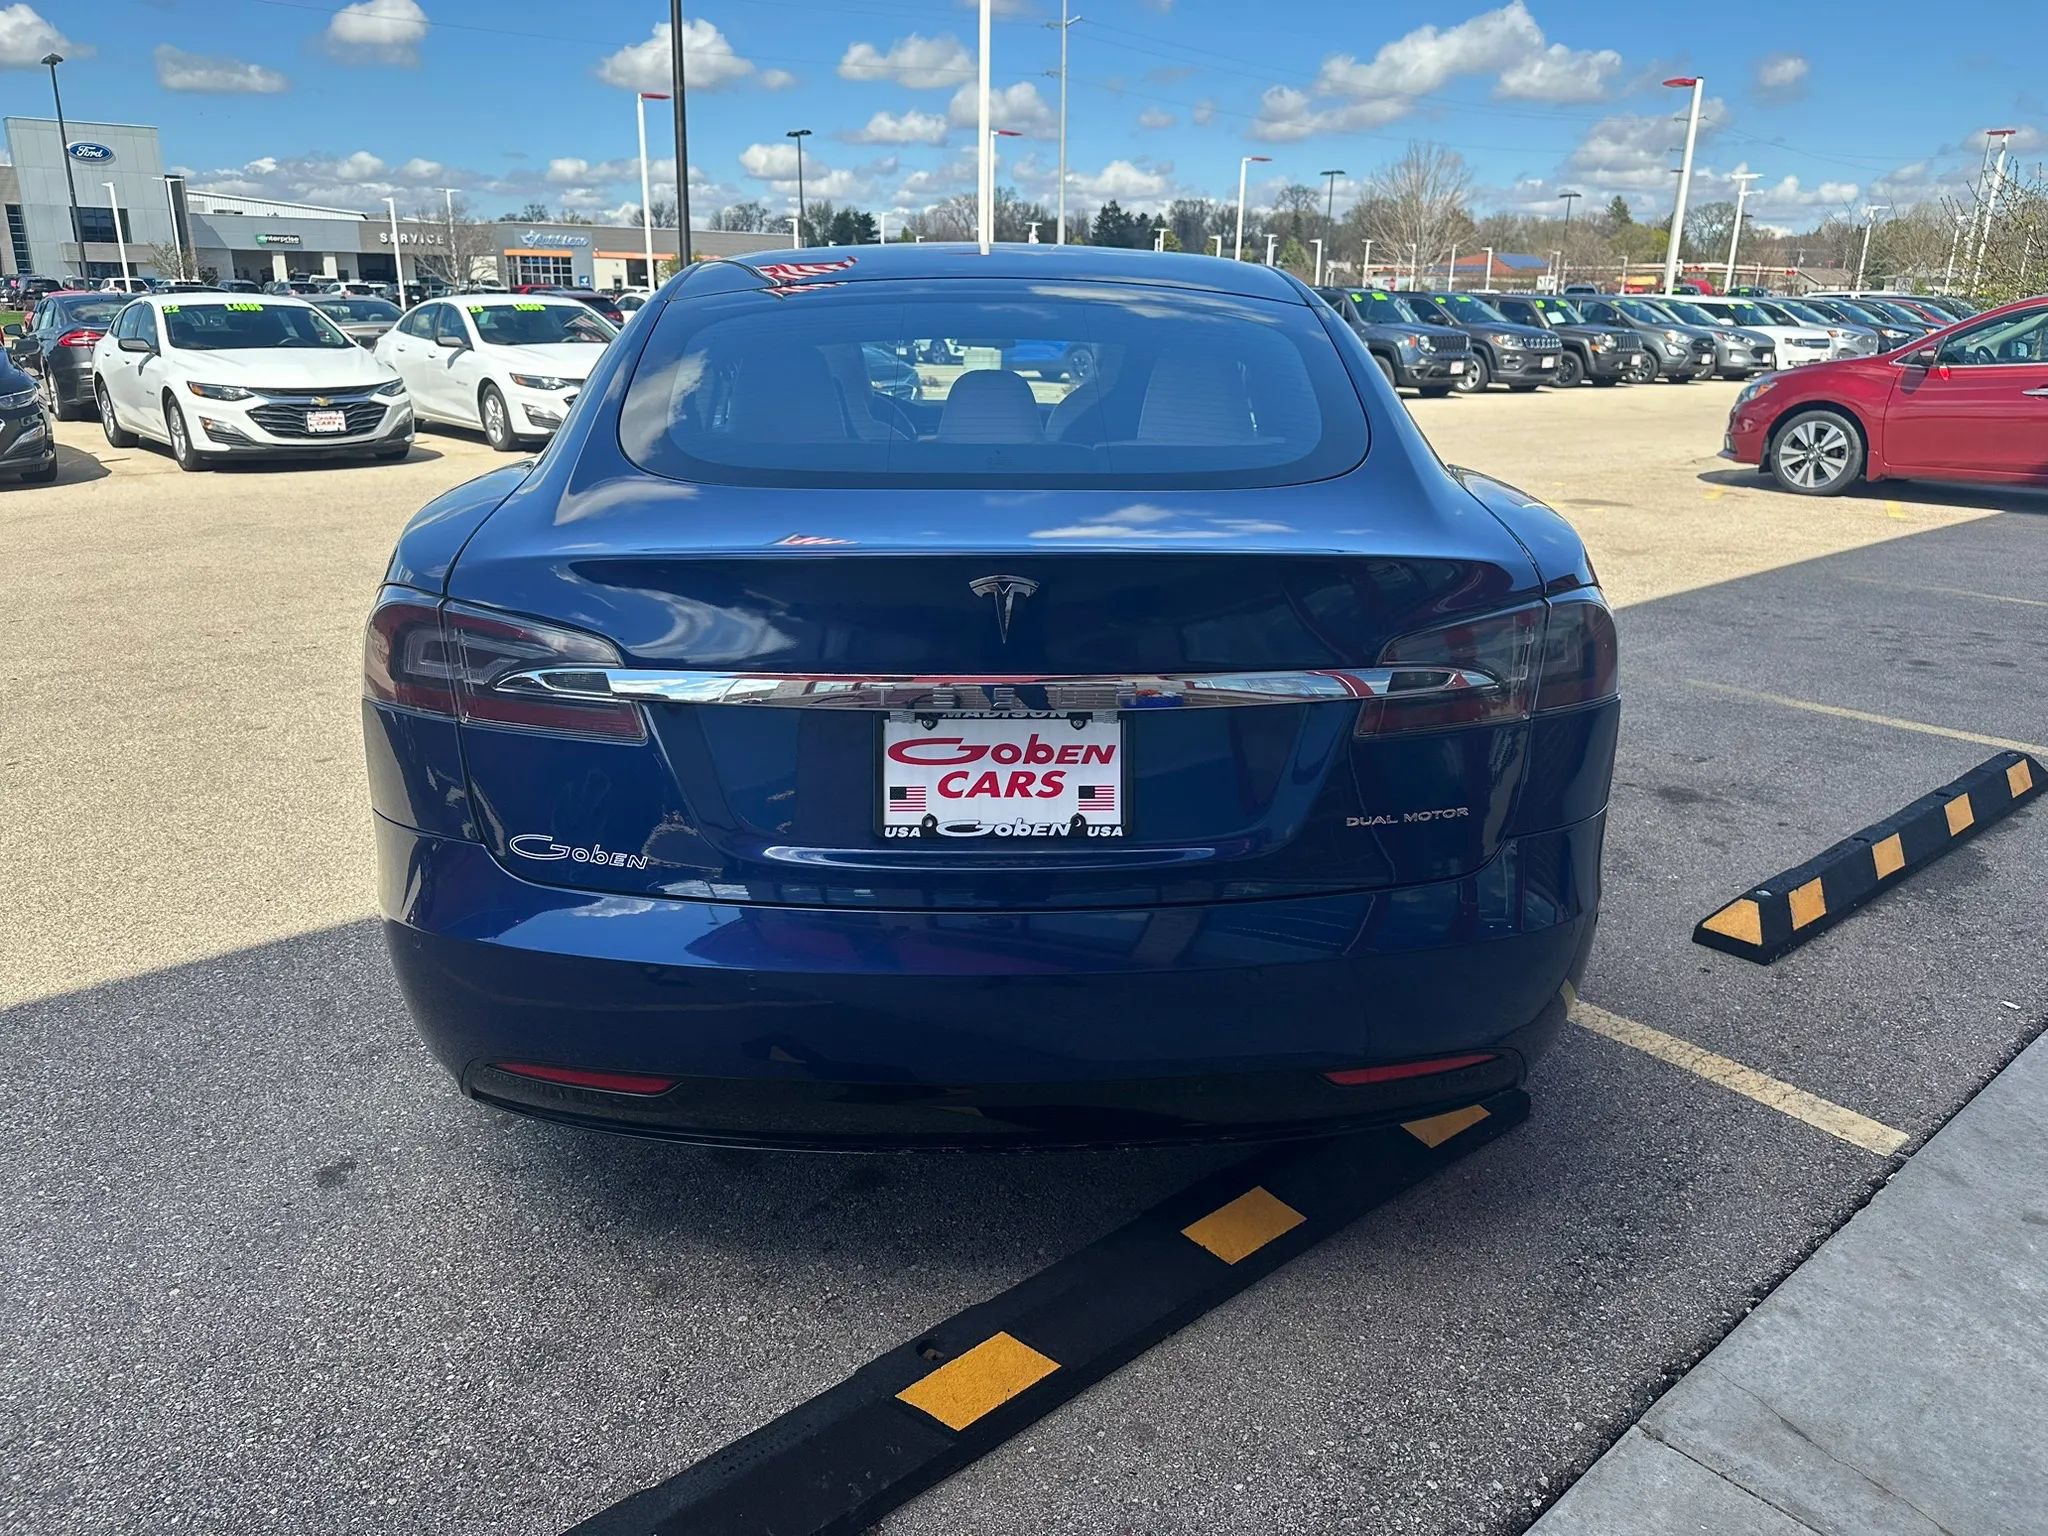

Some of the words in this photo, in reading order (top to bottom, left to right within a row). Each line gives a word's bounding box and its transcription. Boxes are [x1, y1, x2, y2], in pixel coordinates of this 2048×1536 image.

[76, 145, 103, 158] Ford
[936, 770, 1068, 800] CARS
[1346, 814, 1399, 827] DUAL
[1403, 806, 1470, 823] MOTOR
[884, 826, 922, 838] USA
[1086, 824, 1124, 837] USA
